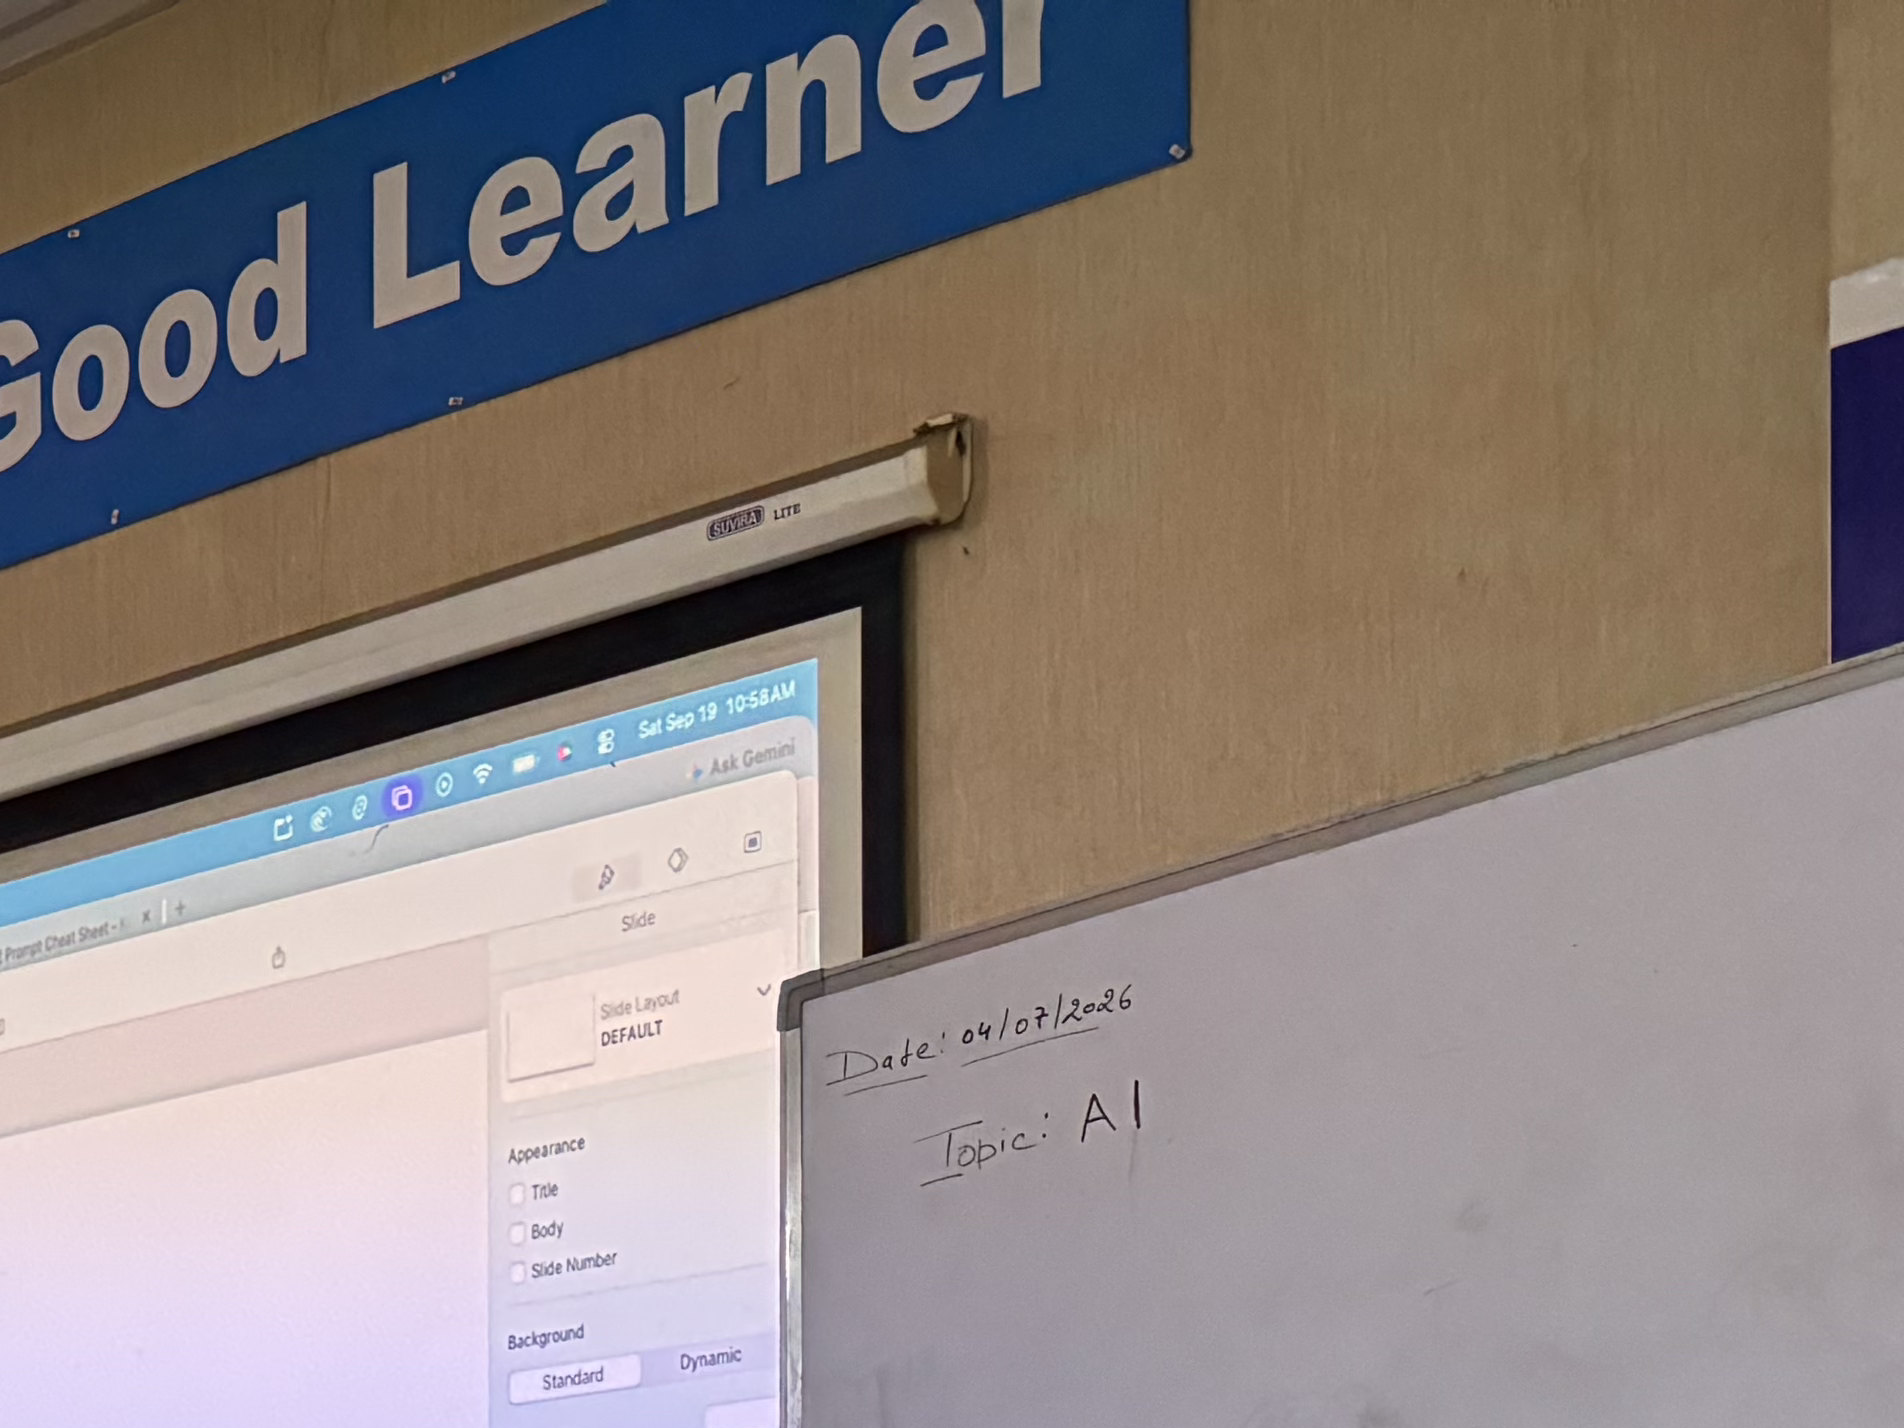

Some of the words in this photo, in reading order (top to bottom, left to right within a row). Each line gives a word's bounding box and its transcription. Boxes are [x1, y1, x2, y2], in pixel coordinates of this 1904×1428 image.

[373, 0, 1045, 328] Learner
[712, 508, 761, 539] SUVIRA
[773, 503, 801, 521] LITE
[638, 717, 662, 740] Sat
[665, 709, 694, 735] Sep
[697, 701, 718, 723] 19
[709, 753, 739, 777] Ask
[742, 736, 796, 770] Gemini
[621, 910, 656, 933] Slide
[5, 938, 43, 963] Prompt
[45, 930, 76, 952] Cheat
[78, 921, 110, 944] Sheet
[600, 998, 633, 1021] Slide
[634, 988, 682, 1015] Layout
[600, 1019, 663, 1048] DEFAULT
[826, 1034, 946, 1086] Date:
[961, 984, 1132, 1041] 04/07/2026
[507, 1136, 586, 1166] Appearance
[913, 1112, 1050, 1170] Topic:
[531, 1182, 559, 1201] Title
[531, 1219, 564, 1242] Body
[531, 1259, 564, 1280] Slide
[566, 1251, 618, 1274] Number
[507, 1323, 586, 1351] Background
[542, 1365, 604, 1391] Standard
[680, 1345, 743, 1373] Dynamic
